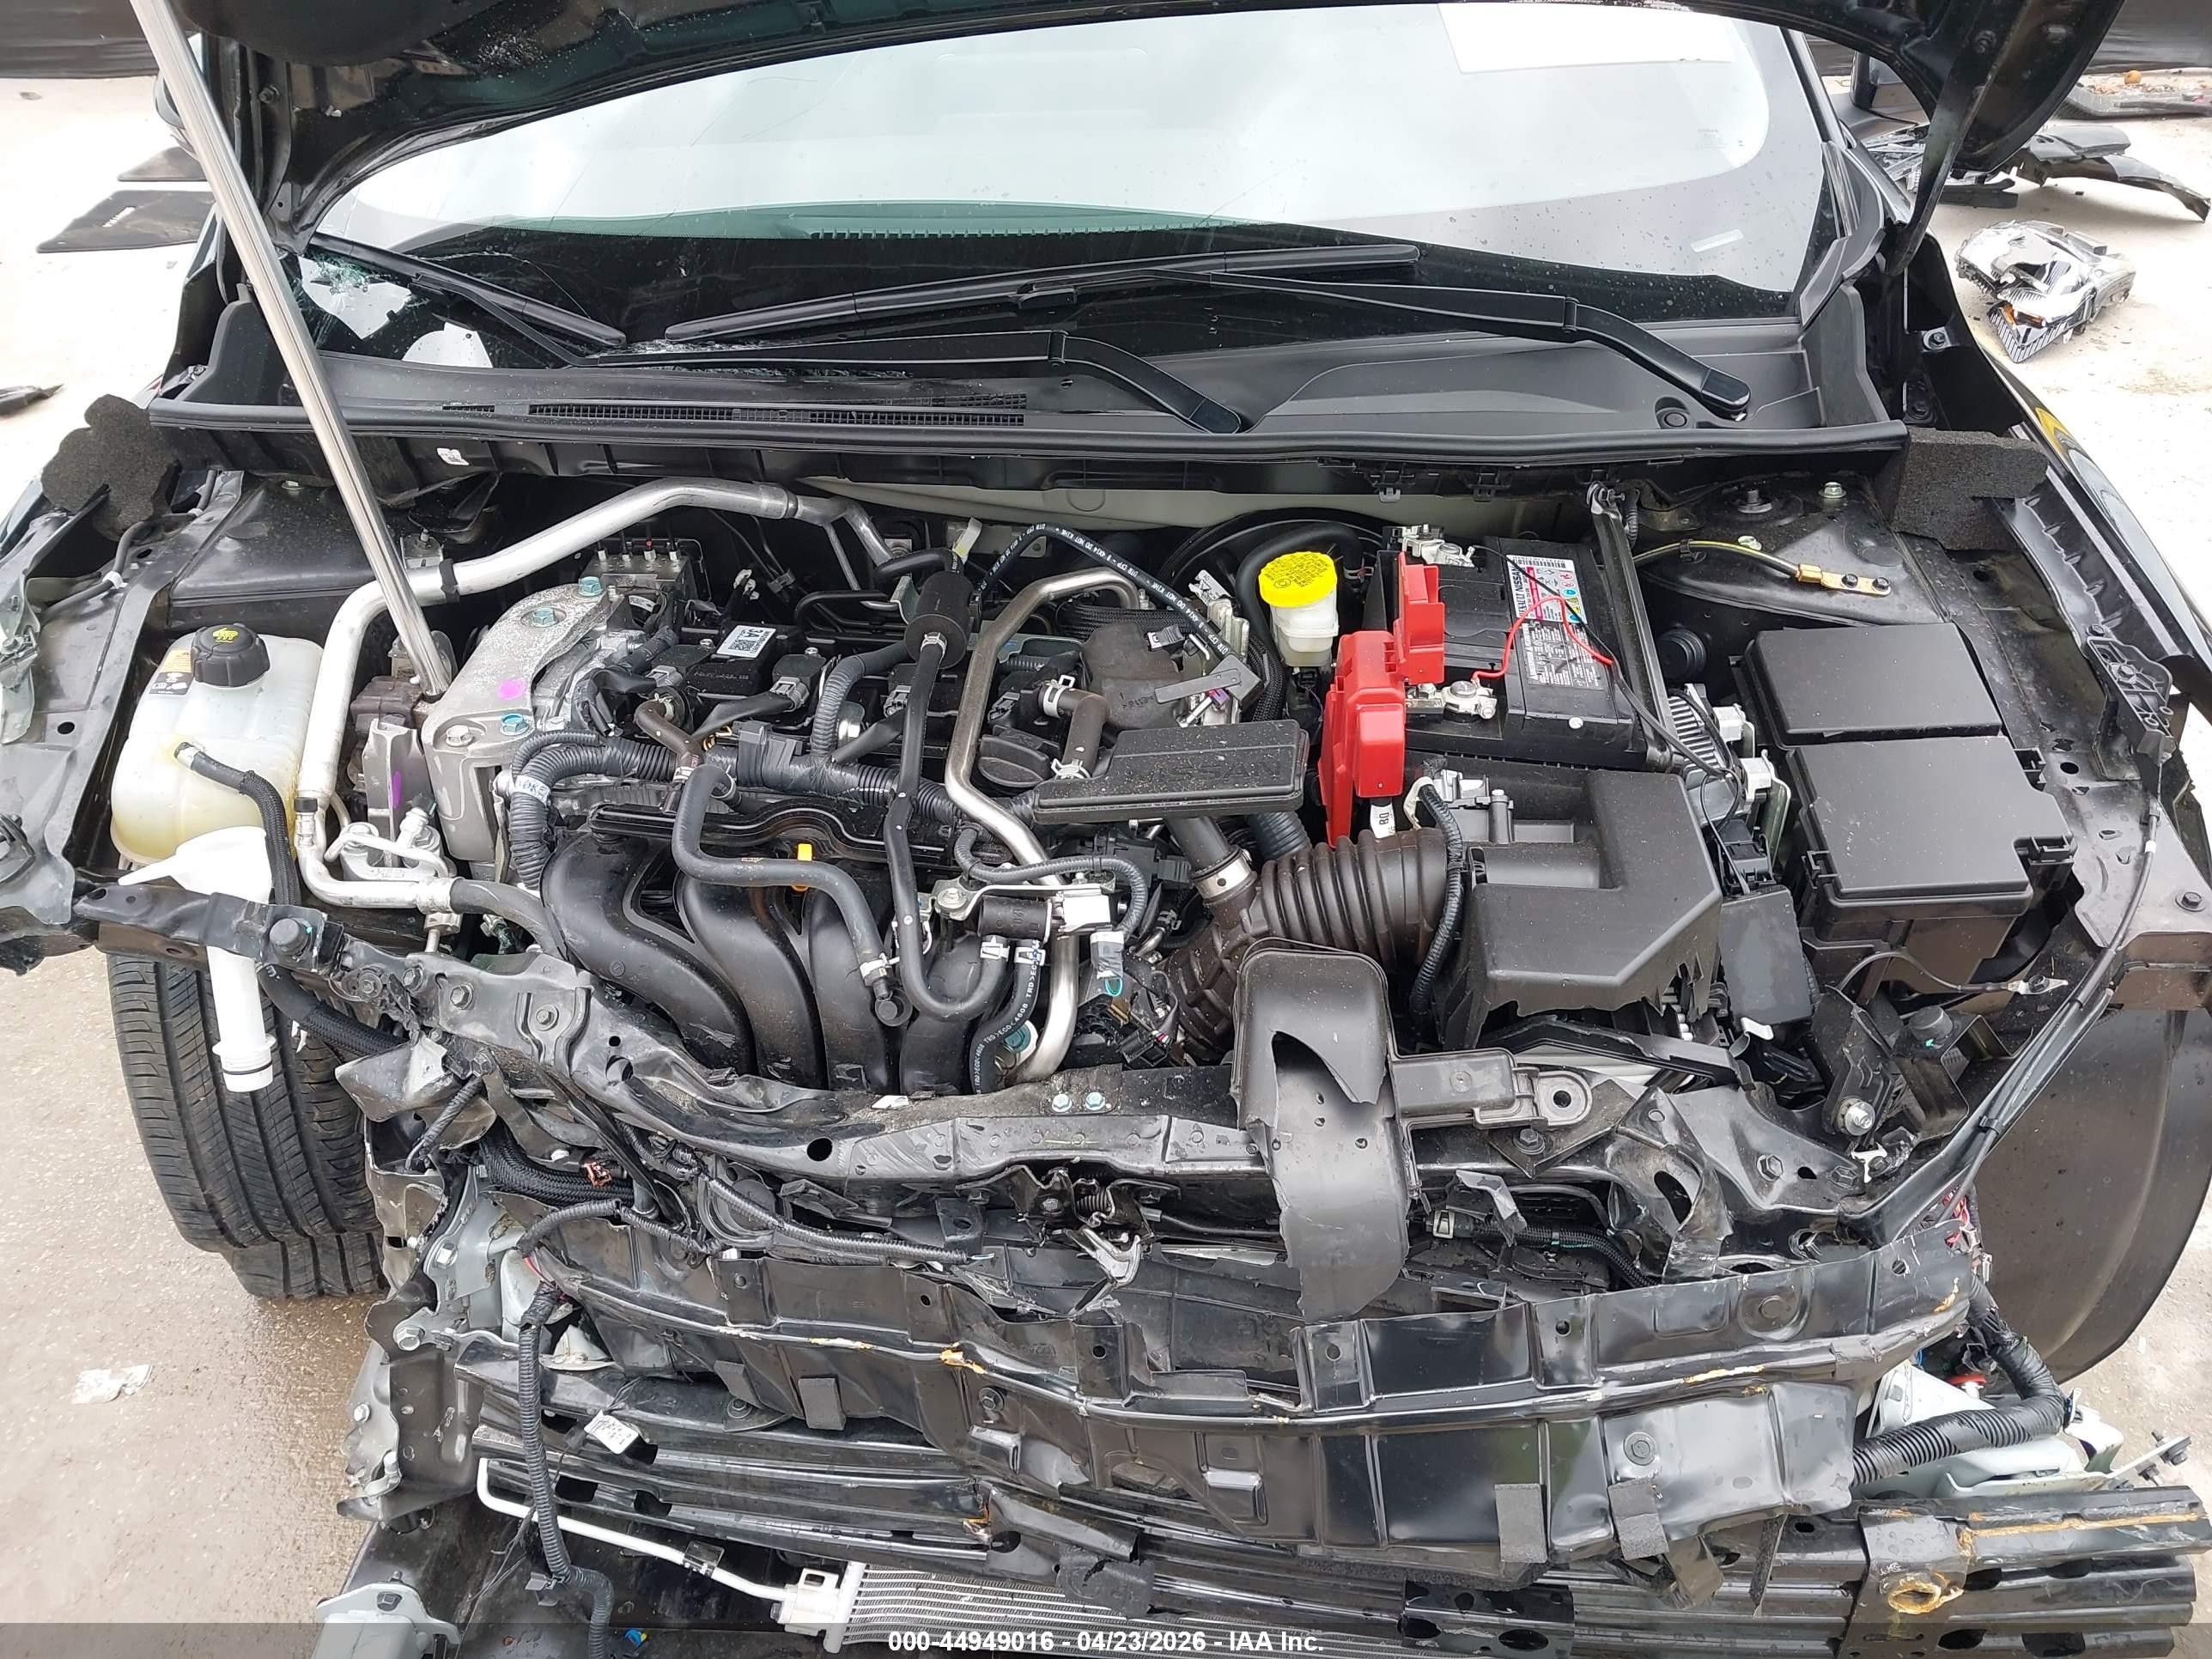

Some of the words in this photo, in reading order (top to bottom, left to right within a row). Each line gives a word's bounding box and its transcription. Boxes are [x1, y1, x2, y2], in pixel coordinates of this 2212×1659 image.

[1060, 529, 1073, 539] KINK
[1074, 537, 1085, 545] NOT
[1152, 582, 1164, 593] KINK
[1165, 592, 1176, 602] NOT
[1176, 600, 1186, 609] DO
